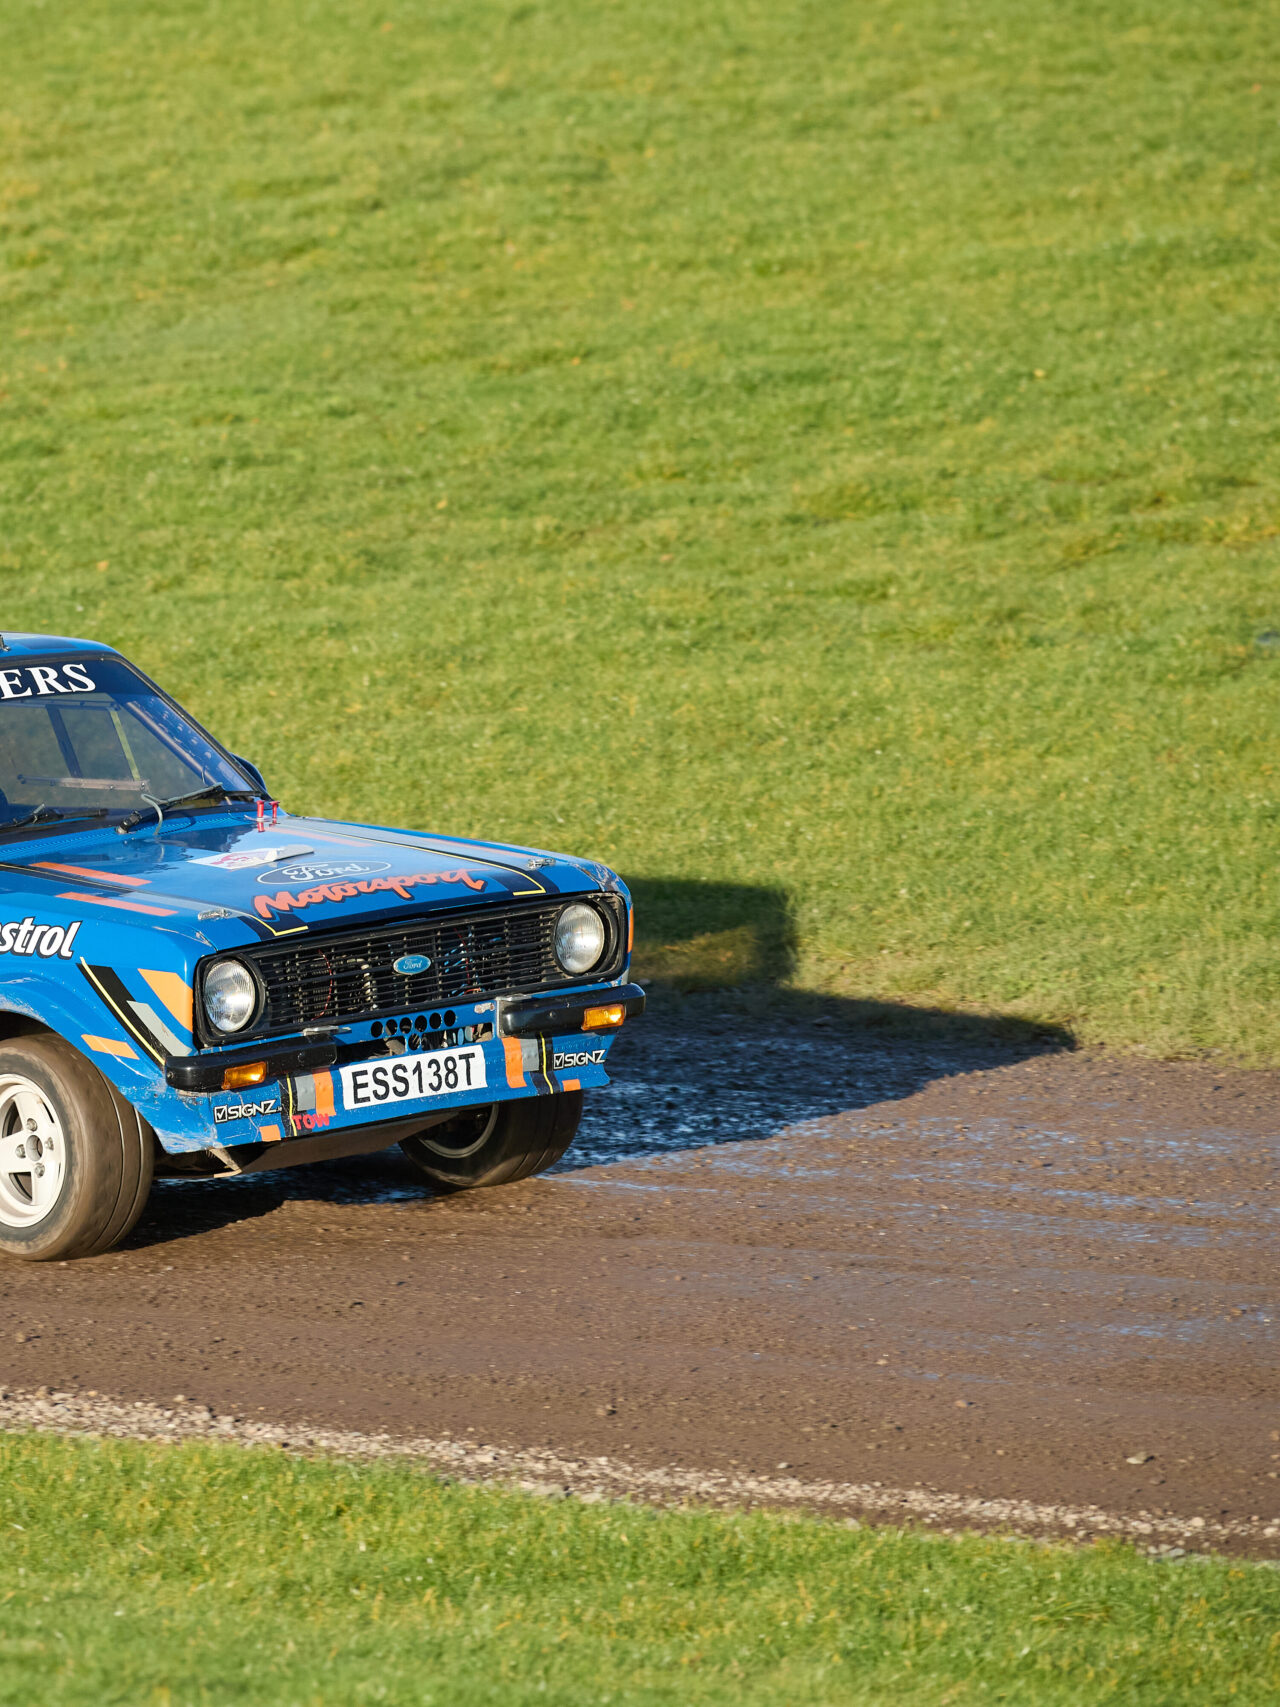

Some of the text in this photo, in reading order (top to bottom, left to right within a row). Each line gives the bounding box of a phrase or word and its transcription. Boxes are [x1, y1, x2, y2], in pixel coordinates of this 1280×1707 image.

[281, 863, 371, 880] Ford
[253, 868, 490, 919] Motorsport
[403, 958, 423, 970] Ford
[351, 1053, 475, 1104] ESS138T
[292, 1113, 330, 1130] TOW
